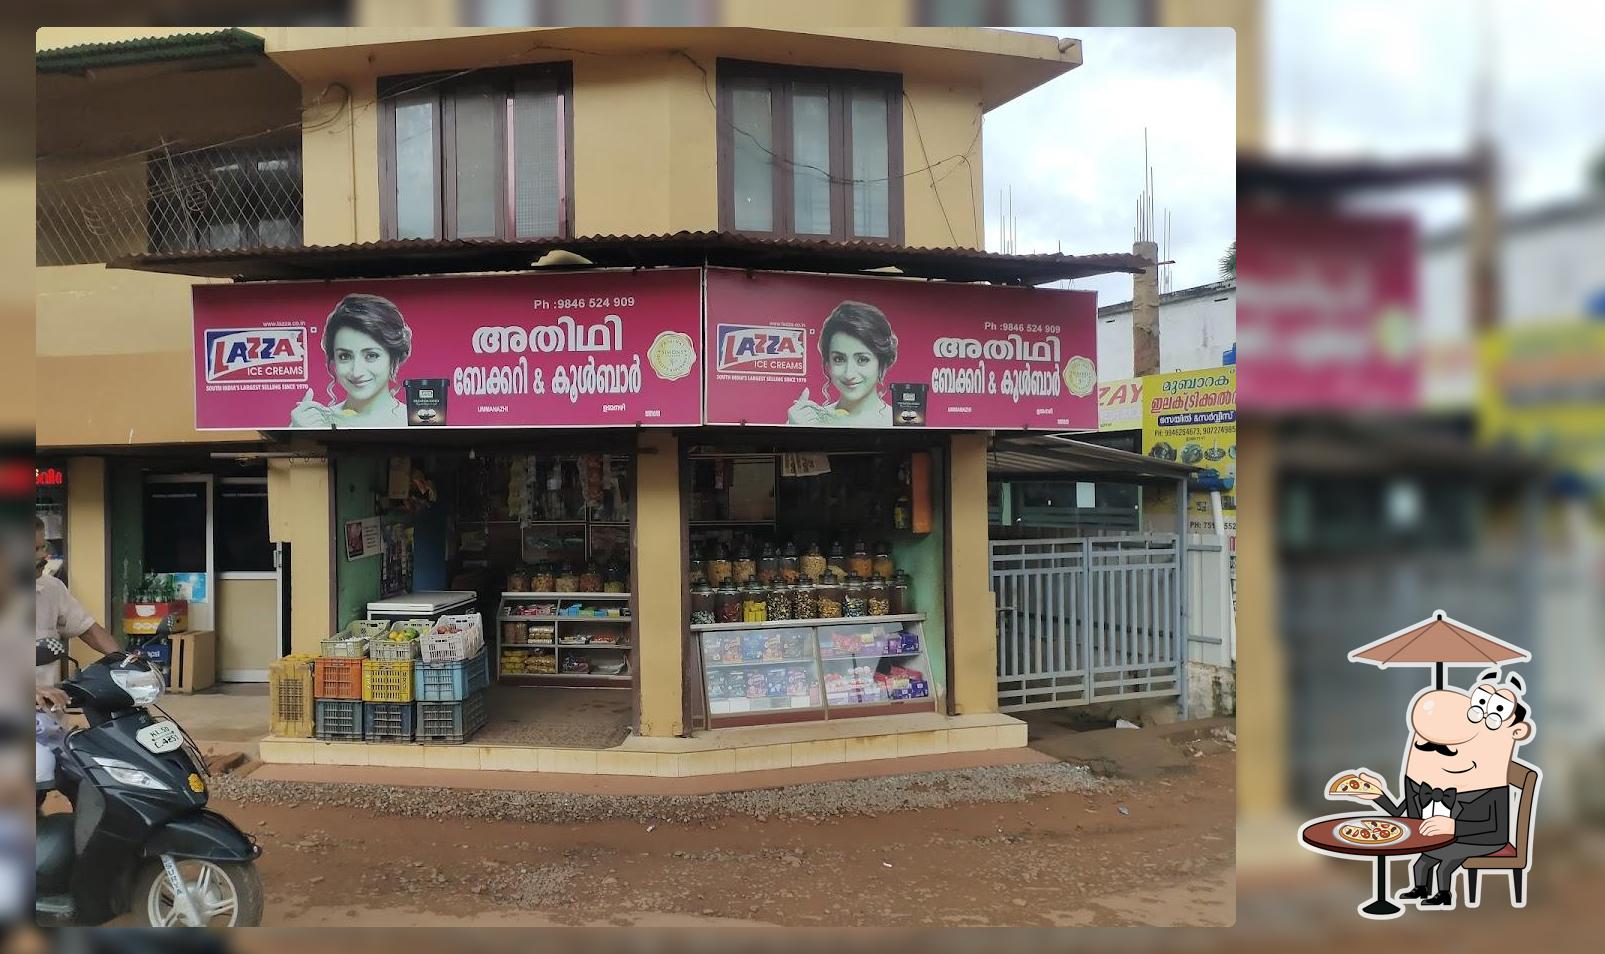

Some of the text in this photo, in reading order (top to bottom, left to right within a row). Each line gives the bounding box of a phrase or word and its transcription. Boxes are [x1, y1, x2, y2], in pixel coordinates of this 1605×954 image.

[534, 300, 549, 309] Ph
[588, 298, 610, 308] 524
[613, 297, 635, 307] 909
[471, 314, 623, 353] അതിഥി
[984, 321, 997, 331] Ph
[1026, 323, 1043, 333] 524
[1044, 324, 1061, 334] 909
[214, 337, 295, 375] LAZZA
[724, 334, 796, 365] LAZZA
[933, 333, 1061, 362] അതിഥി
[247, 366, 304, 376] ICE CREAMS
[453, 355, 528, 396] ബേക്കറി
[533, 367, 546, 394] &
[754, 360, 803, 370] ICE CREAMS
[931, 360, 985, 394] ബേക്കറി
[988, 370, 997, 395] &
